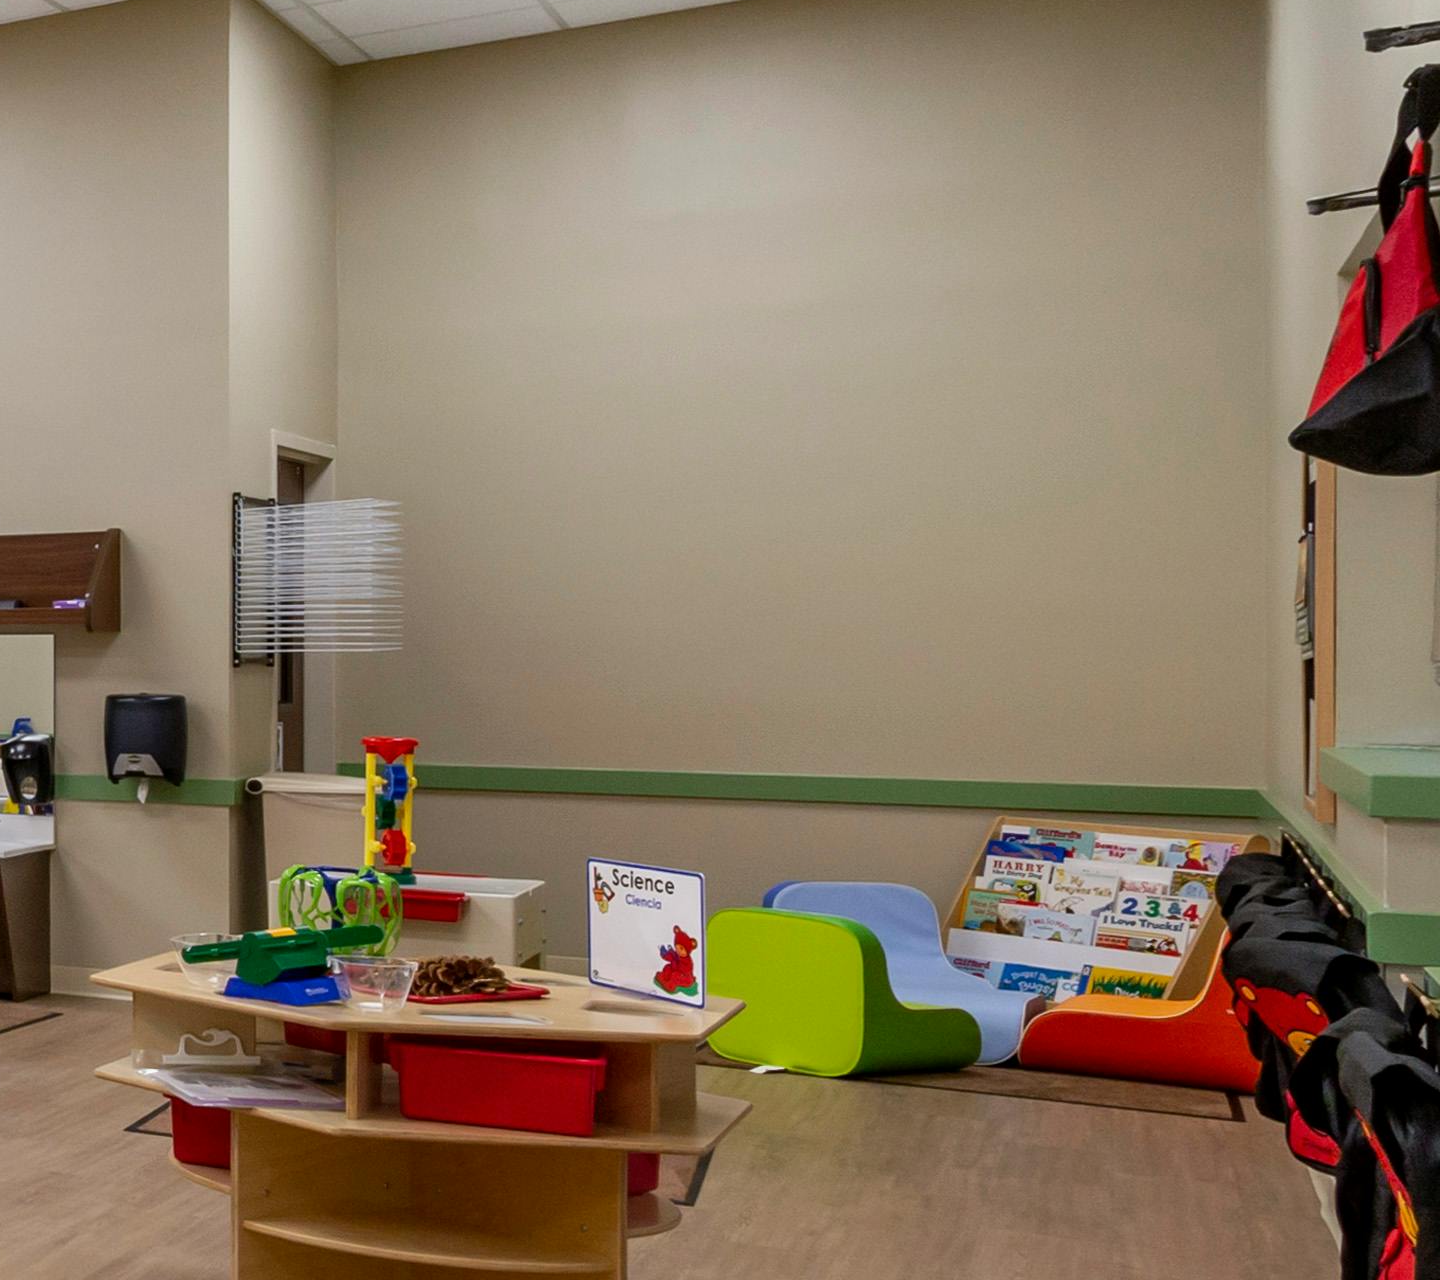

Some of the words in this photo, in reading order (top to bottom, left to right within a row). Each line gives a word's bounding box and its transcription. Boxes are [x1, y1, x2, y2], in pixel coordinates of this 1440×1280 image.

[993, 860, 1045, 873] HARRY
[1006, 870, 1026, 879] Dirty
[612, 868, 675, 895] Science
[625, 894, 662, 910] Ciencia
[1168, 902, 1181, 915] &
[1103, 915, 1109, 924] I
[1110, 916, 1137, 927] Love
[1138, 918, 1185, 933] Trucks!
[1018, 980, 1055, 997] Bugs!
